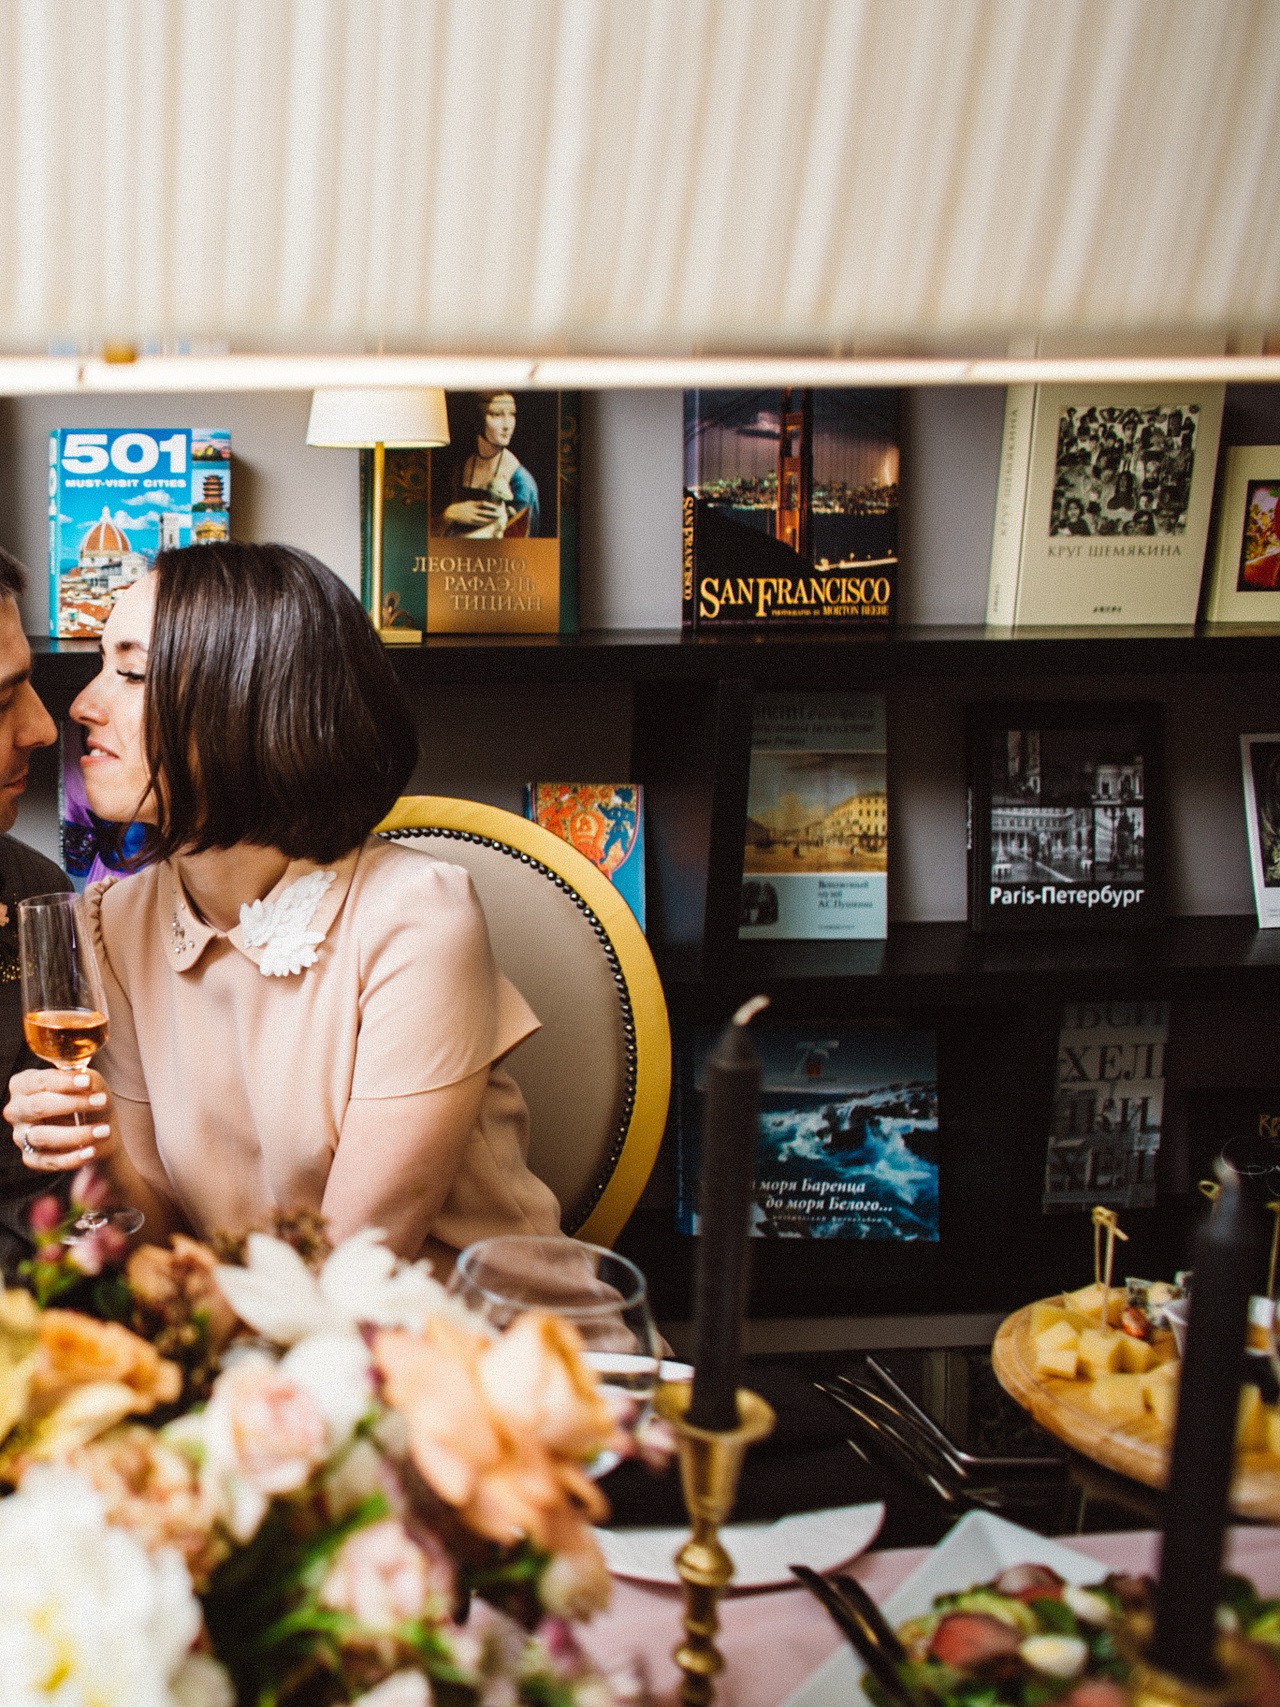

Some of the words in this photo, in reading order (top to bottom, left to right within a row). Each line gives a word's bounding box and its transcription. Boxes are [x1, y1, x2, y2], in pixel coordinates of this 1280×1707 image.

[61, 433, 187, 474] 501
[65, 479, 139, 488] MUST-VISIT
[143, 479, 187, 488] CITIES
[1048, 545, 1082, 557] КРУГ
[1088, 545, 1182, 557] ШЕМЯКИНА
[412, 556, 526, 573] ЛЕОНАРДО
[444, 576, 536, 592] РАФАЭЛЬ
[450, 594, 542, 611] ТИЦИАН
[823, 605, 859, 616] MORTON
[990, 885, 1145, 908] Paris-Петербург
[759, 1180, 798, 1195] моря
[801, 1178, 867, 1196] Баренца
[765, 1194, 784, 1210] до
[787, 1200, 825, 1214] моря
